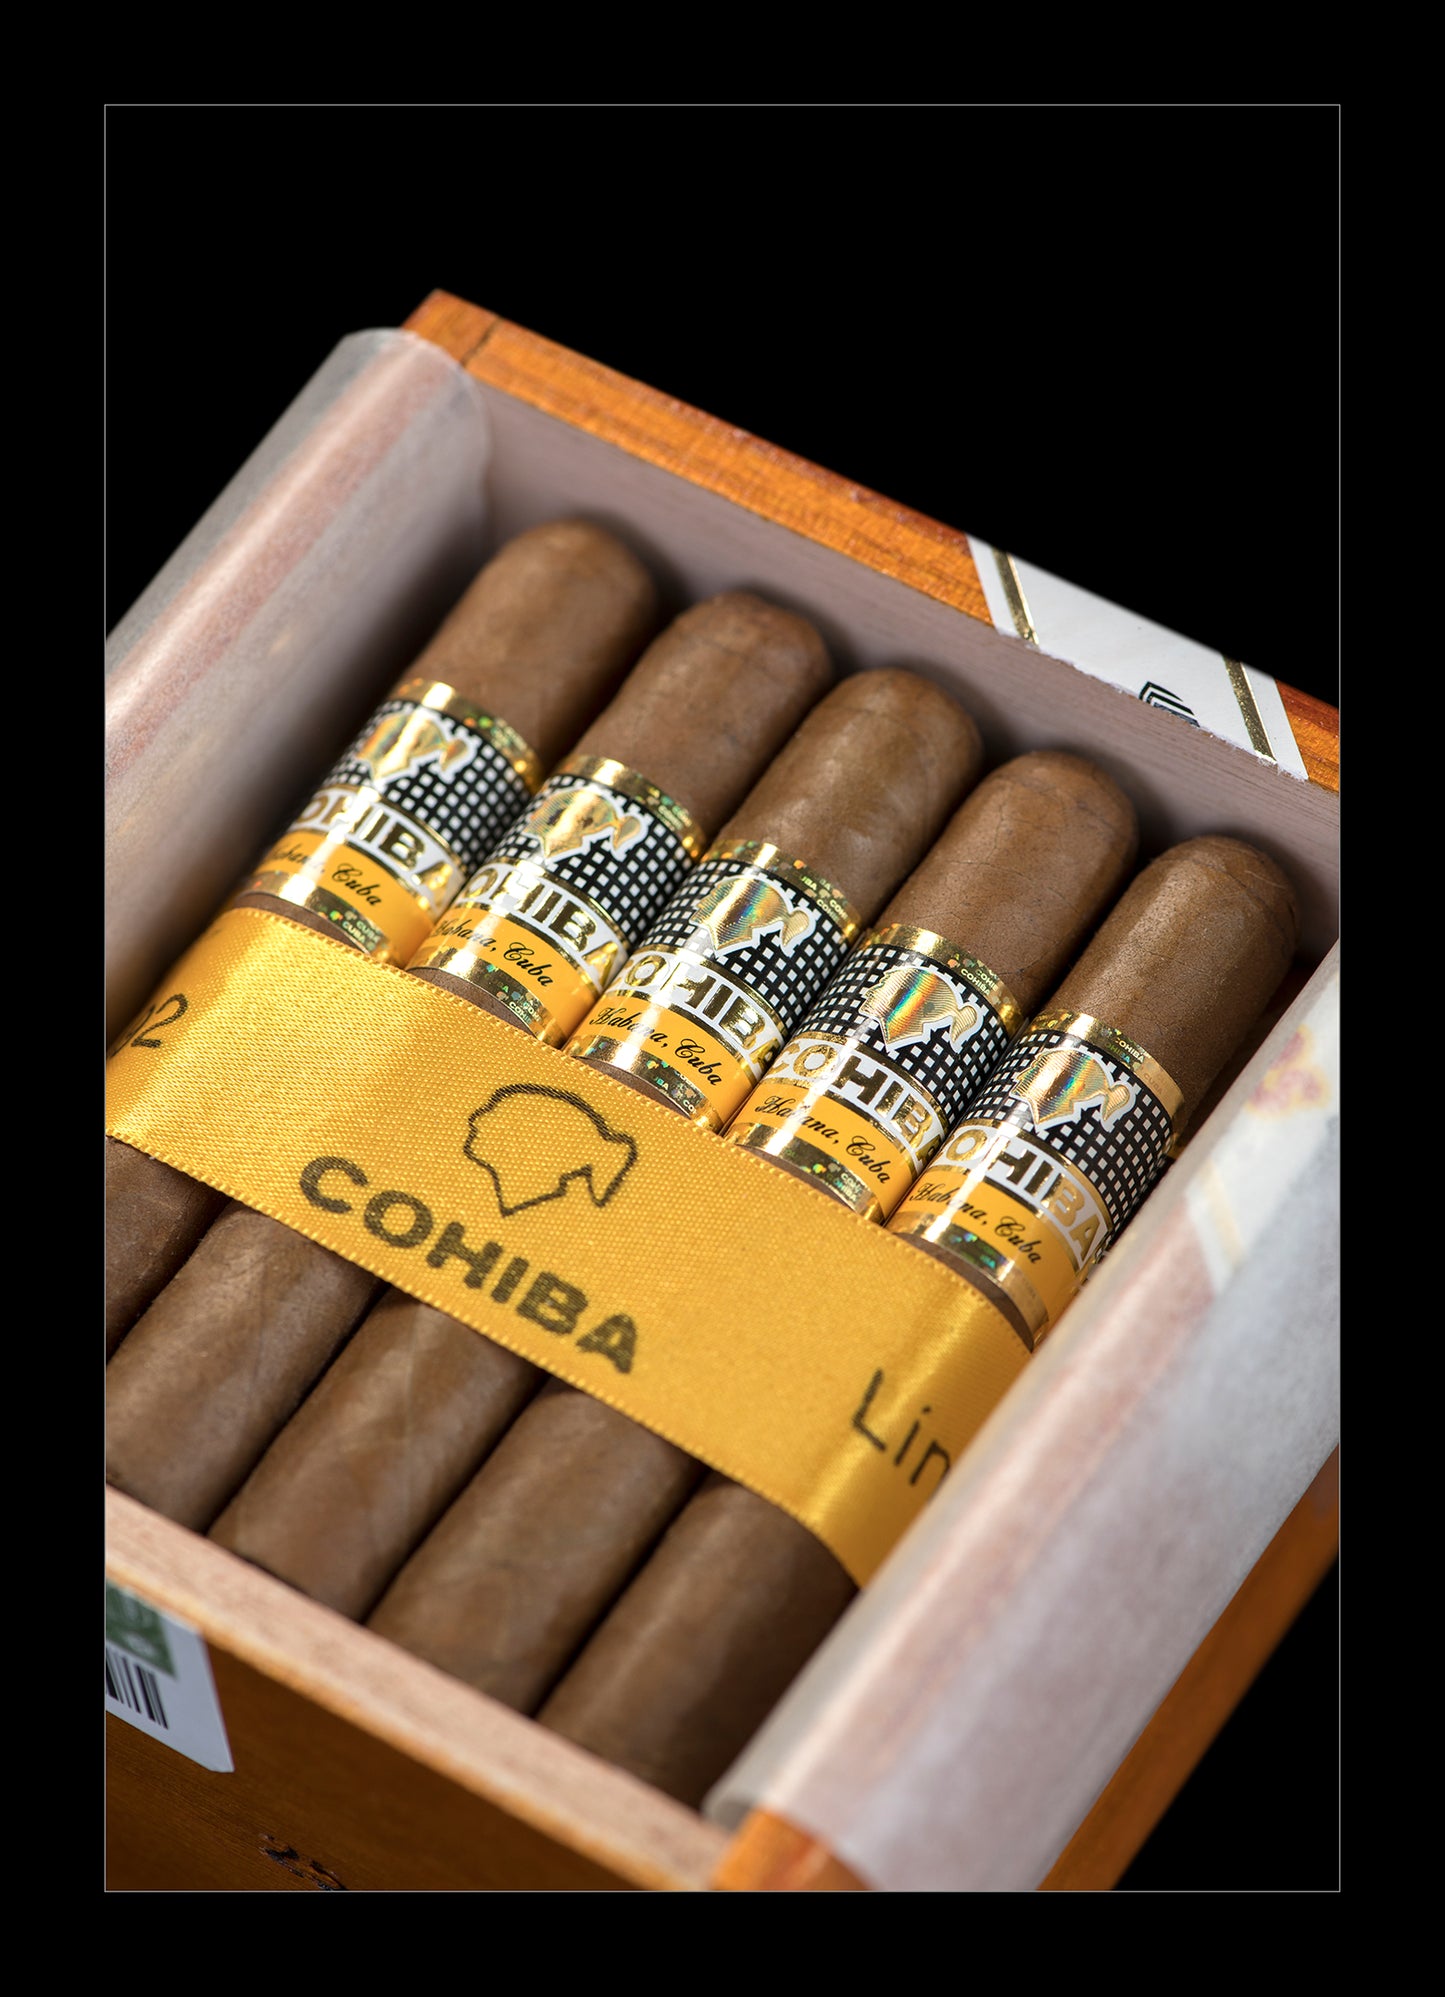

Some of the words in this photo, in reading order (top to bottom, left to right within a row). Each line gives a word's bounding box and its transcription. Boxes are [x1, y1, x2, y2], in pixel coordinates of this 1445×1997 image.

[332, 863, 382, 906] Cuba
[503, 941, 554, 987] Cuba
[606, 955, 780, 1072] OHIBA
[675, 1038, 722, 1086] Cuba
[755, 1095, 840, 1145] Haana,
[846, 1135, 890, 1184] Cuba
[932, 1129, 1101, 1262] OHIBA
[300, 1156, 638, 1375] COHIBA
[994, 1216, 1042, 1264] Cuba
